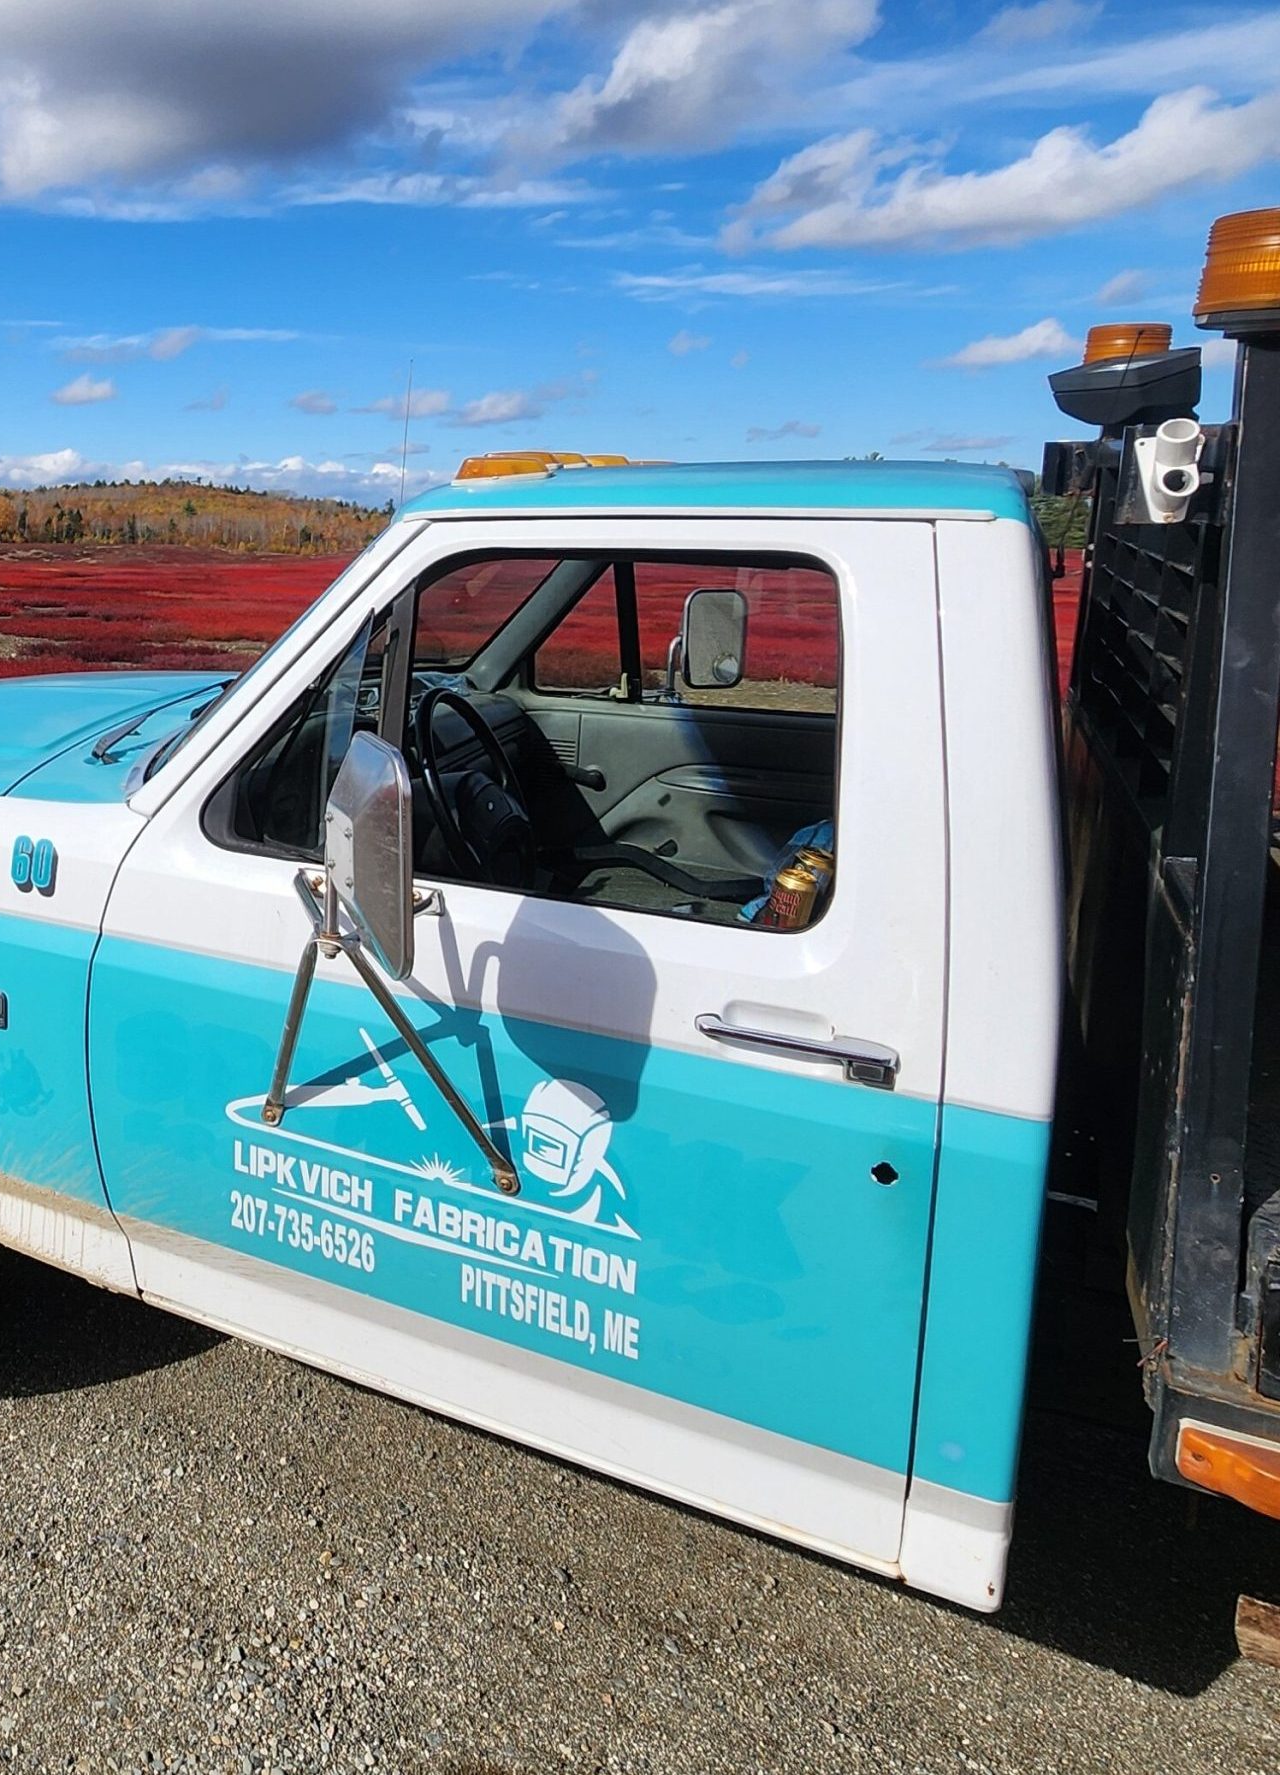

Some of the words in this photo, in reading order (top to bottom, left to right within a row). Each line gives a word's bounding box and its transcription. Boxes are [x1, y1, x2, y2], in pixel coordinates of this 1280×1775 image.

[11, 835, 59, 897] 60
[230, 1190, 376, 1273] 207-735-6526
[394, 1189, 637, 1294] FABRICATION
[461, 1263, 597, 1354] PITTSFIELD,
[603, 1309, 641, 1361] ME
